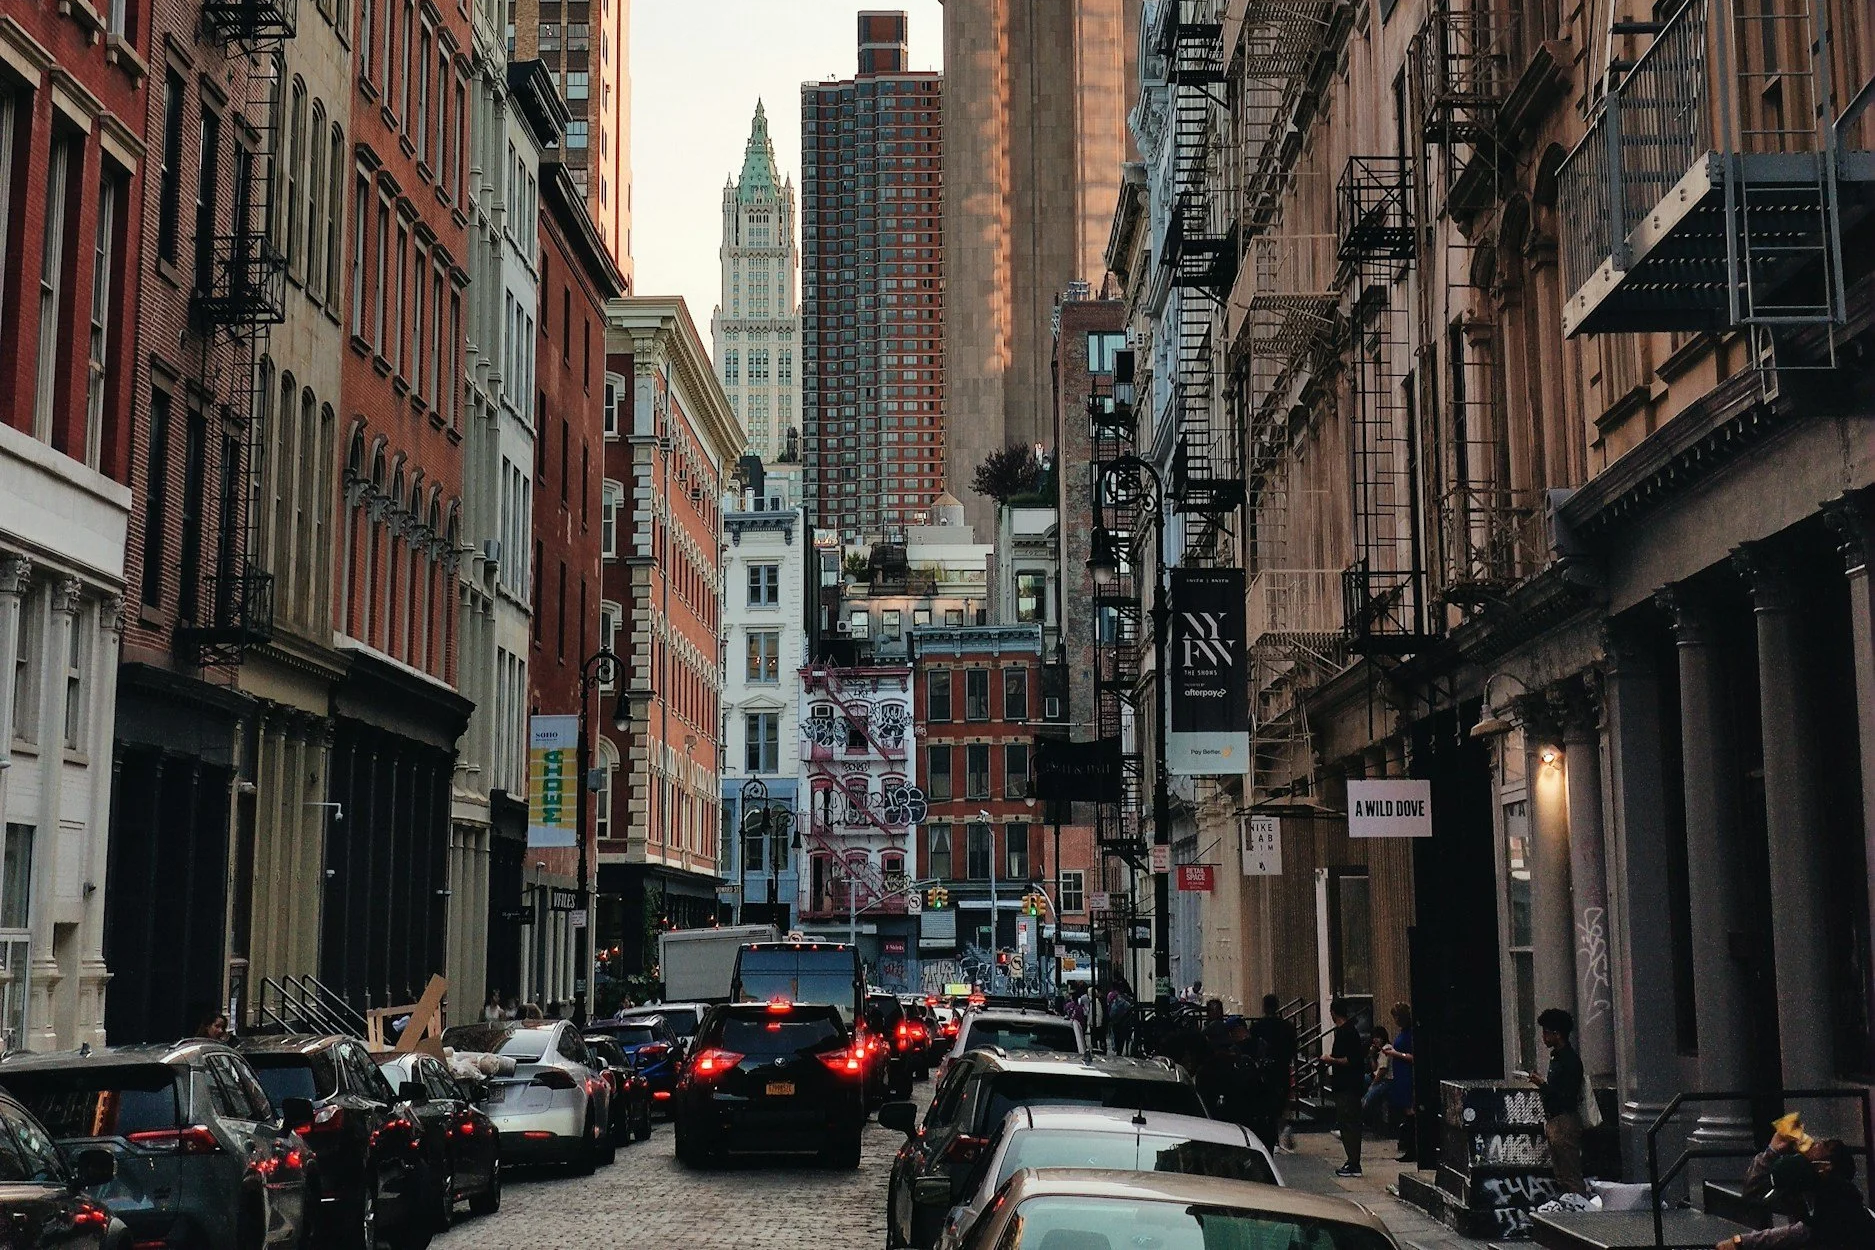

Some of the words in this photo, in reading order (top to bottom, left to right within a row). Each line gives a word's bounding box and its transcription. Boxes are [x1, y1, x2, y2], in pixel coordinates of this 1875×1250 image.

[1184, 689, 1218, 698] afterpay
[542, 750, 564, 823] MEDIA
[1355, 800, 1363, 817] A
[1365, 800, 1393, 817] WILD
[1396, 800, 1425, 817] DOVE
[1185, 873, 1206, 881] SPACE
[553, 892, 577, 909] VFILES
